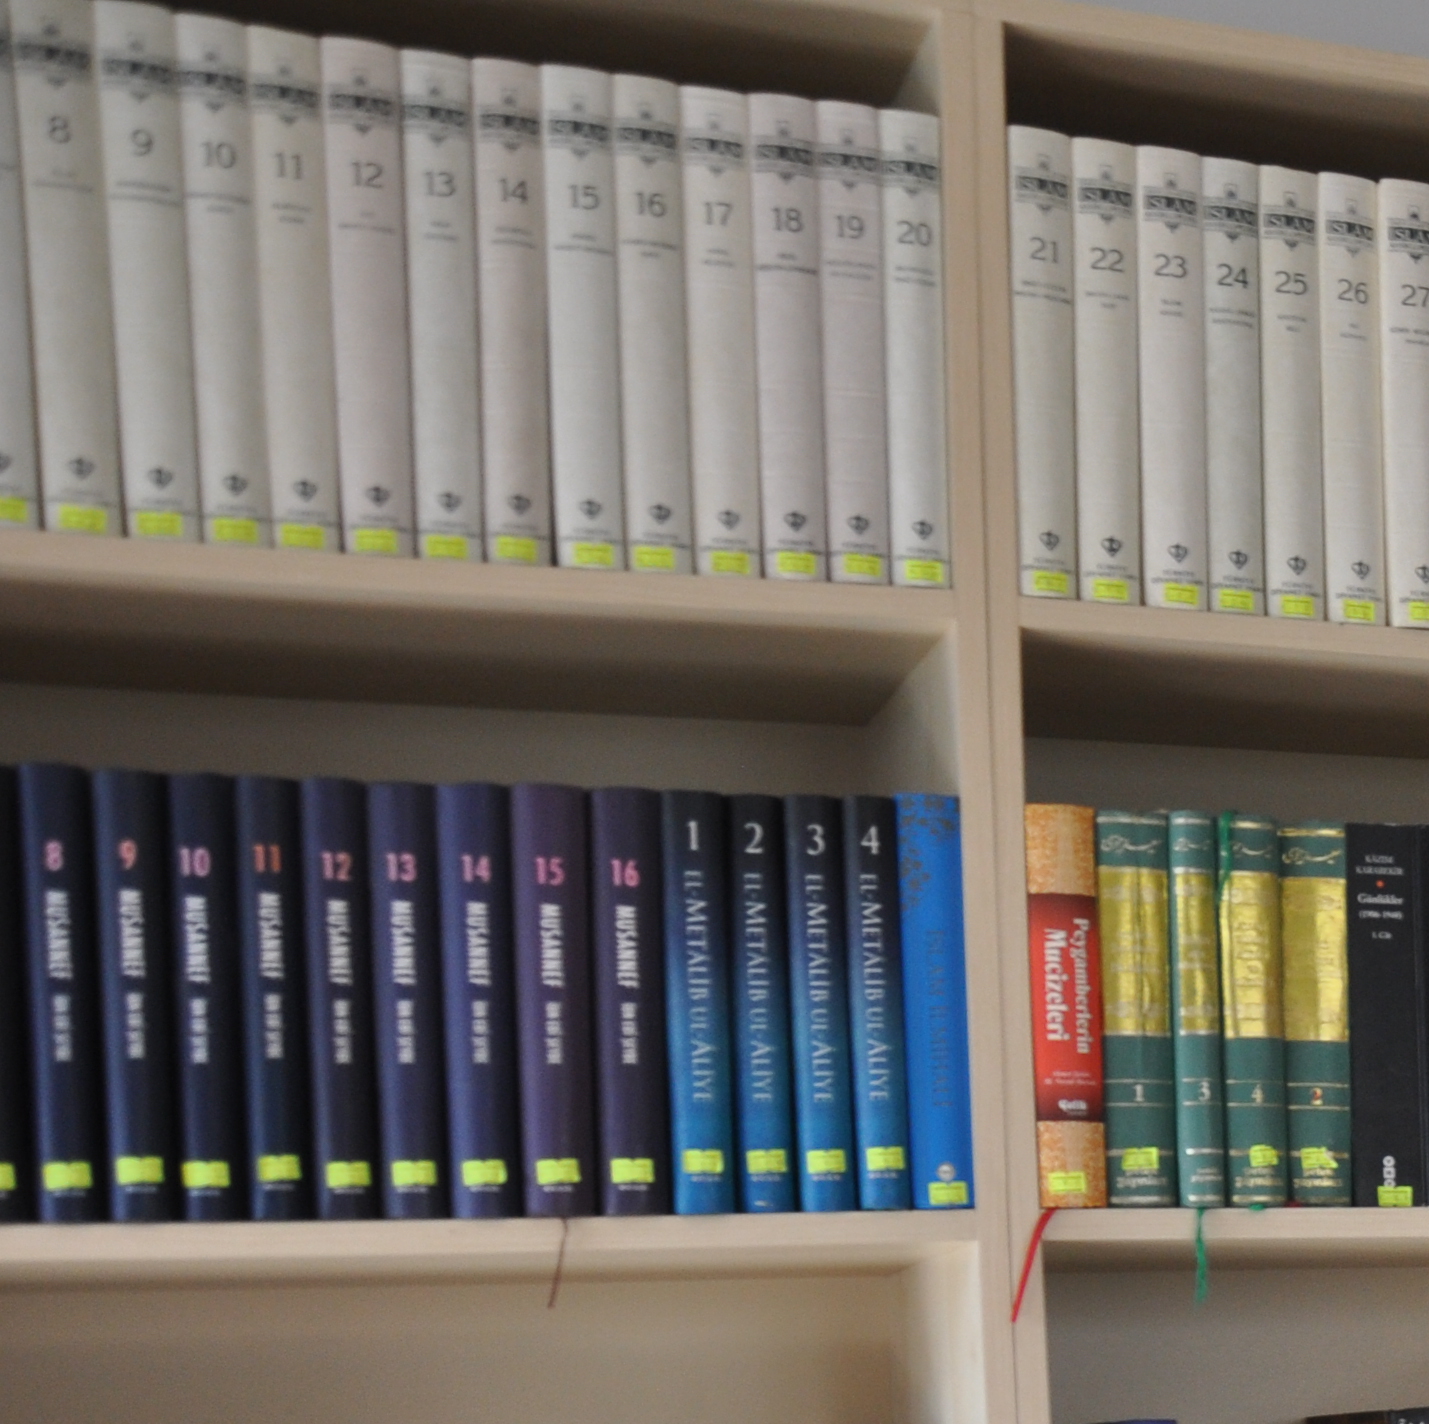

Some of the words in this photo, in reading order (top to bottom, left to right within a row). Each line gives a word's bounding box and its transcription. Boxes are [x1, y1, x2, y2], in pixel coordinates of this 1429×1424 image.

[49, 115, 72, 144] 8
[201, 141, 237, 170] 10
[571, 184, 602, 211] 15
[774, 207, 805, 234] 18
[899, 220, 934, 248] 20
[1031, 236, 1060, 265] 21
[1276, 270, 1310, 296] 25
[687, 821, 700, 851] 1
[744, 822, 763, 854] 2
[806, 823, 825, 856] 3
[860, 825, 880, 855] 4
[44, 841, 65, 871] 8
[119, 840, 136, 869] 9
[321, 851, 348, 880] 12
[611, 859, 638, 887] 16
[1044, 928, 1070, 1041] Mucizeleri
[1070, 918, 1093, 1054] Peygamberlerin
[1134, 1084, 1144, 1102] 1
[1199, 1081, 1211, 1101] 3
[1252, 1084, 1263, 1104] 4
